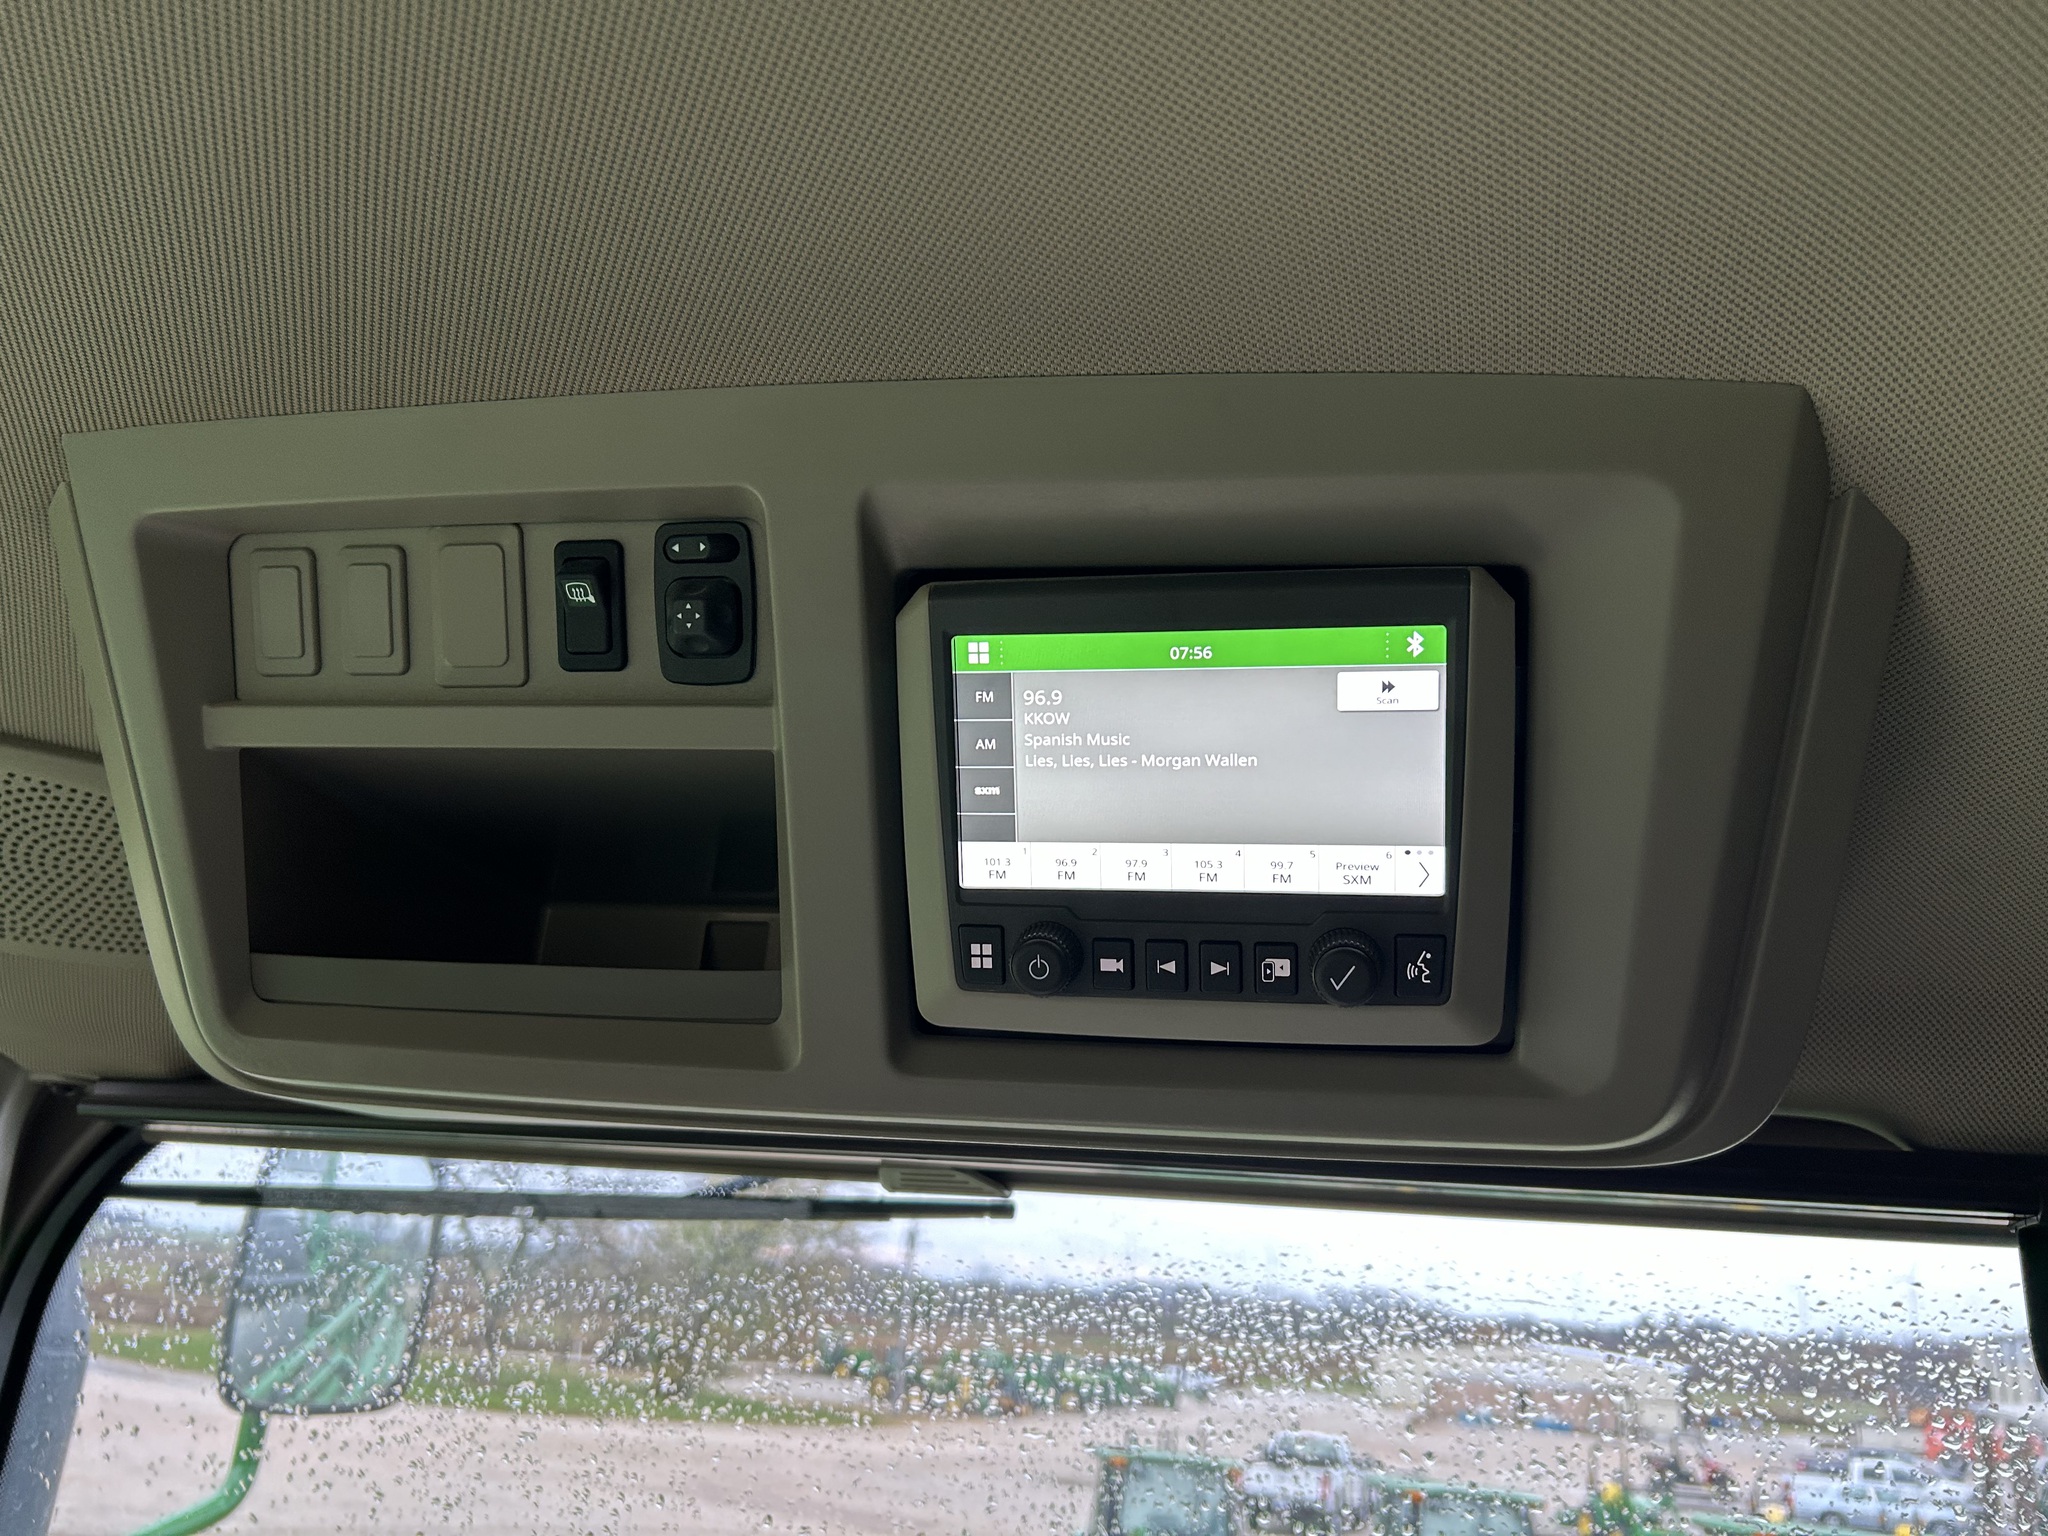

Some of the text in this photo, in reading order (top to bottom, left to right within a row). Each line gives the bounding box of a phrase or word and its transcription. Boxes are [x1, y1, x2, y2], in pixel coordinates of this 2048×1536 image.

[1169, 646, 1213, 660] 07:56
[975, 691, 994, 703] FM
[1022, 689, 1063, 706] 96.9
[1376, 697, 1399, 705] Scan
[1024, 712, 1070, 725] KKOW
[975, 739, 996, 750] AM
[1024, 733, 1131, 749] Spanish Music
[1025, 754, 1058, 769] Lies,
[1062, 754, 1094, 769] Lies,
[1099, 754, 1128, 767] Lies
[1141, 754, 1201, 770] Morgan
[1204, 754, 1258, 767] Wallen
[1092, 848, 1097, 856] 2
[1163, 849, 1169, 857] 3
[1310, 850, 1316, 858] 5
[1386, 852, 1393, 860] 6
[984, 858, 1011, 866] 1013
[1055, 859, 1077, 867] 96.9
[1125, 860, 1148, 868] 97.9
[1270, 861, 1294, 870] 99.7
[1336, 862, 1380, 871] Preview
[989, 870, 1007, 879] FM
[1058, 871, 1076, 880] FM
[1128, 872, 1146, 881] FM
[1199, 873, 1218, 882] FM
[1272, 874, 1292, 883] FM
[1343, 875, 1372, 885] SXM
